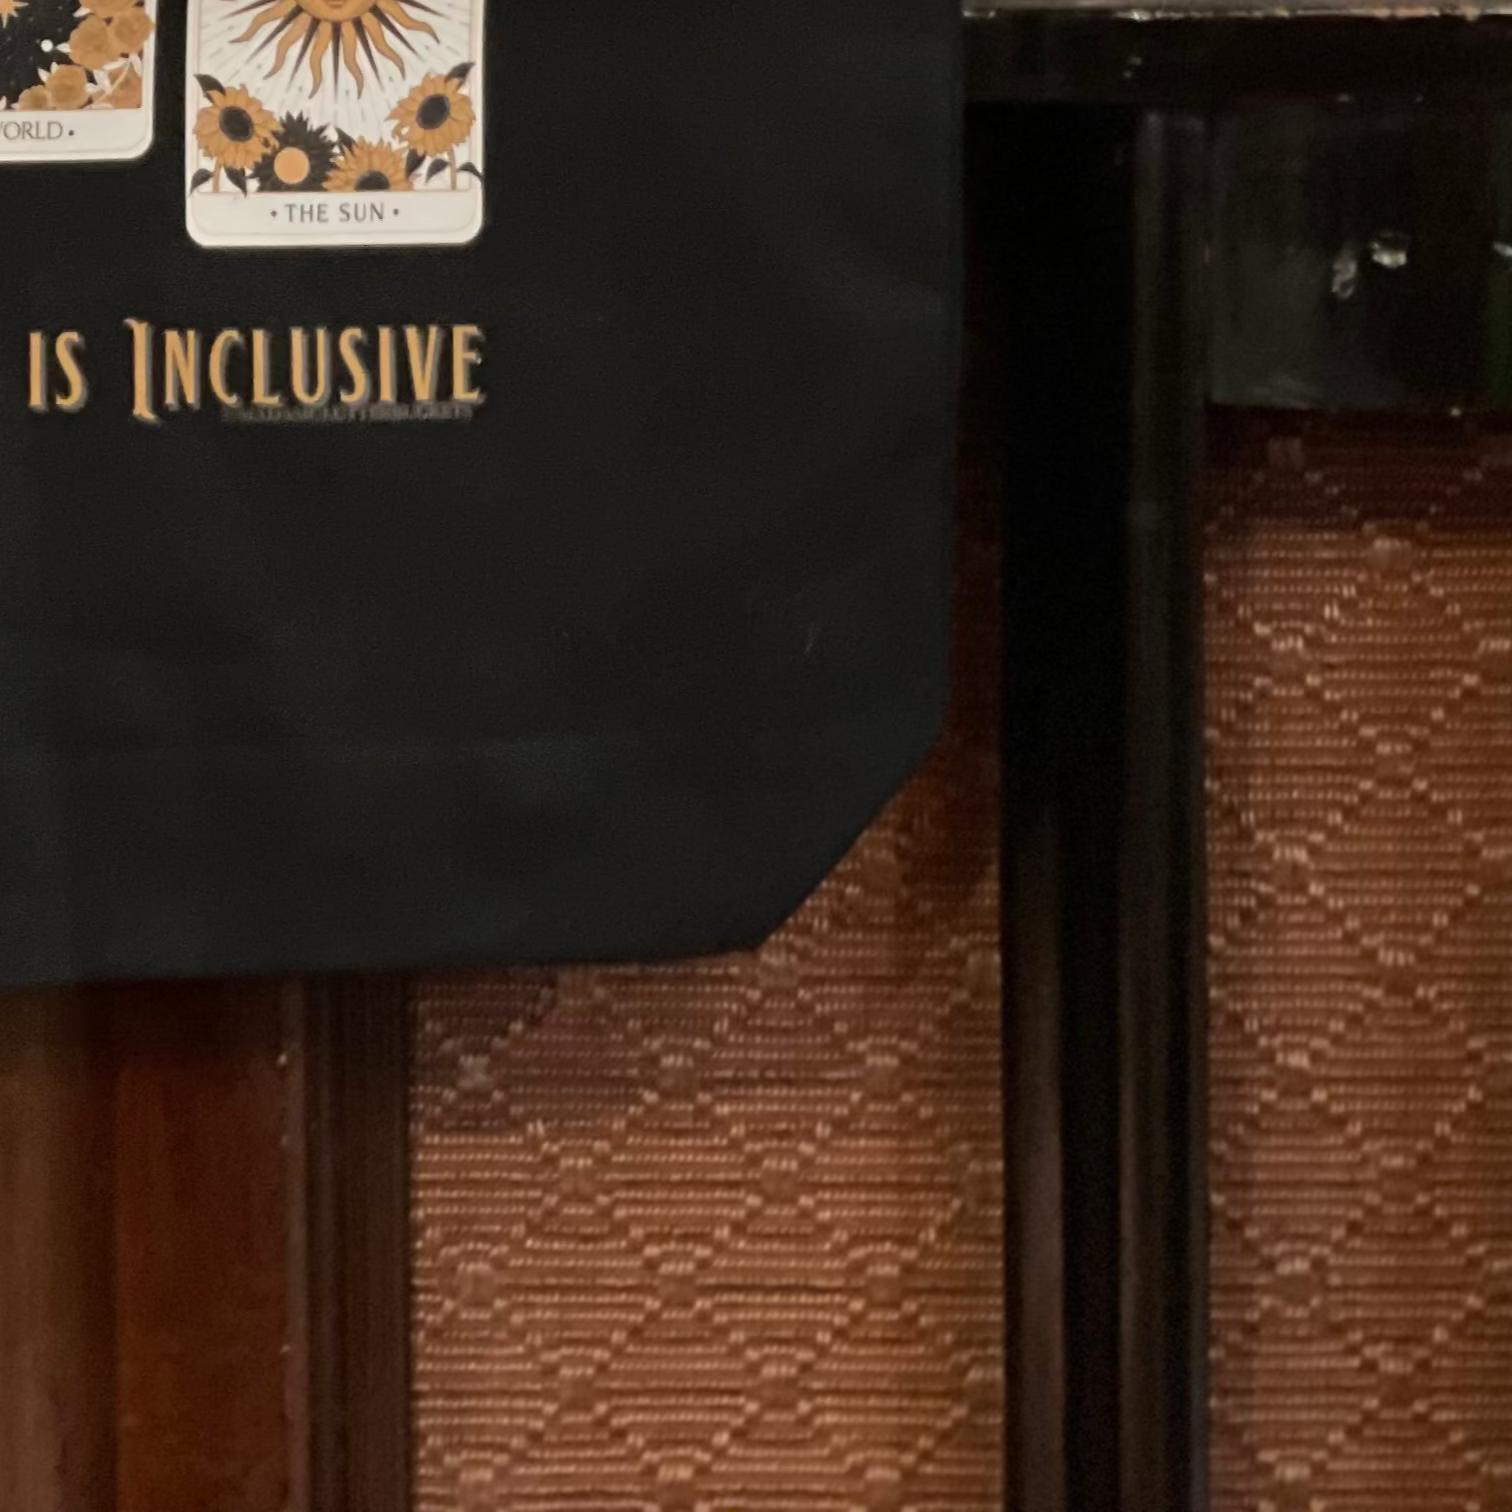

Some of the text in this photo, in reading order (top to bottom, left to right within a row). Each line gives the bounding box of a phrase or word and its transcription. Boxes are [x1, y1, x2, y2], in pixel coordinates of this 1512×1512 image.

[285, 202, 385, 223] THE SUN
[29, 330, 88, 412] IS
[124, 318, 484, 425] INCLUSIVE
